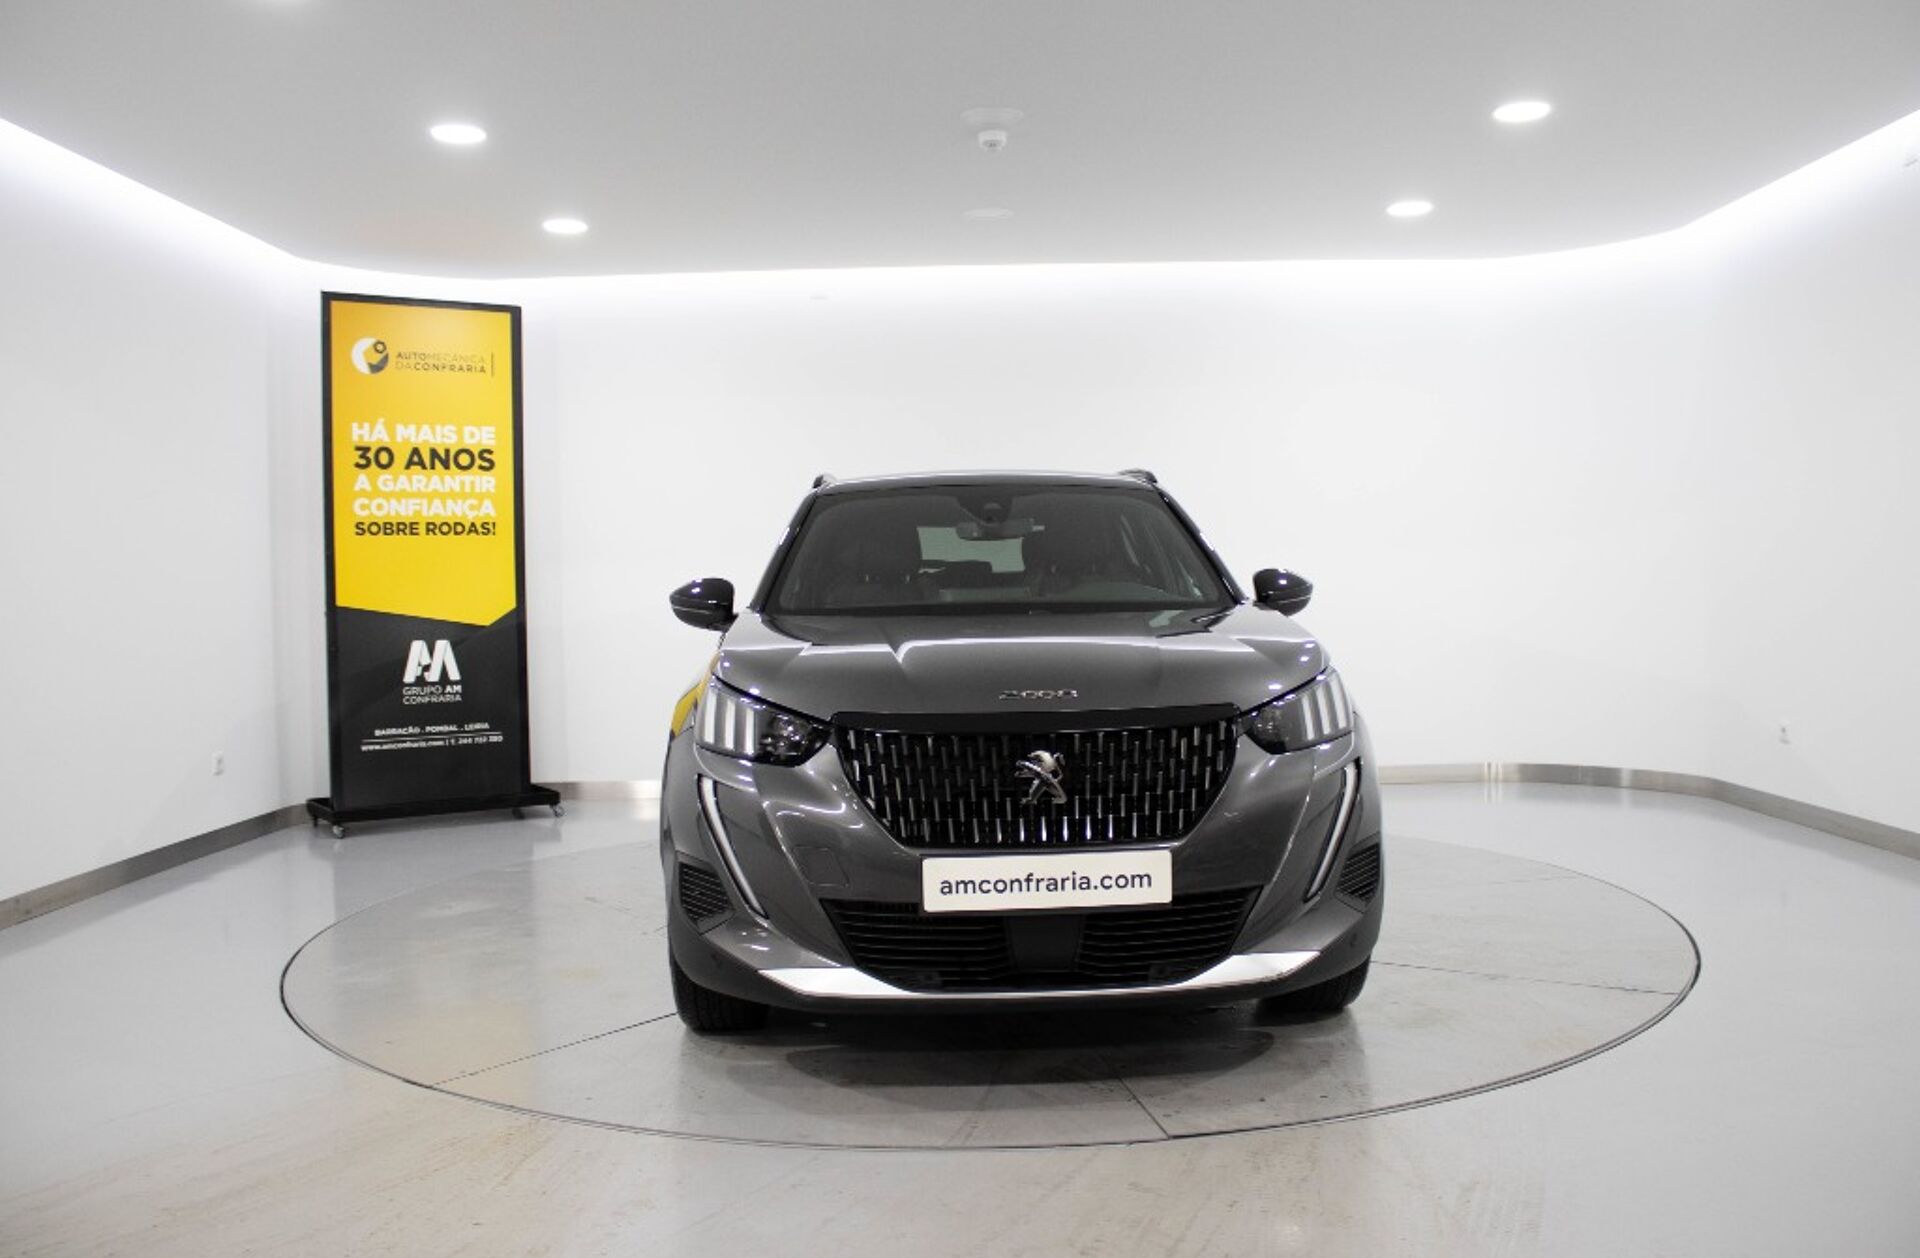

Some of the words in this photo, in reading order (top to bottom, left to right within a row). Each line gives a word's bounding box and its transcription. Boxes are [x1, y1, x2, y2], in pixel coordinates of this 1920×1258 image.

[351, 417, 390, 442] HÁ
[395, 424, 458, 444] MAIS
[463, 425, 496, 446] DE
[353, 446, 395, 470] 30
[404, 447, 496, 472] ANOS
[354, 473, 372, 492] A
[376, 474, 496, 493] GARANTIR
[352, 497, 496, 520] CONFIANÇA
[355, 521, 420, 536] SOBRE
[425, 521, 496, 536] RODAS!
[402, 685, 443, 696] GRUPO
[444, 684, 462, 694] AM
[402, 694, 463, 705] CONFRARIA
[999, 689, 1079, 701] 2008
[939, 871, 1153, 896] amconfraria.com
